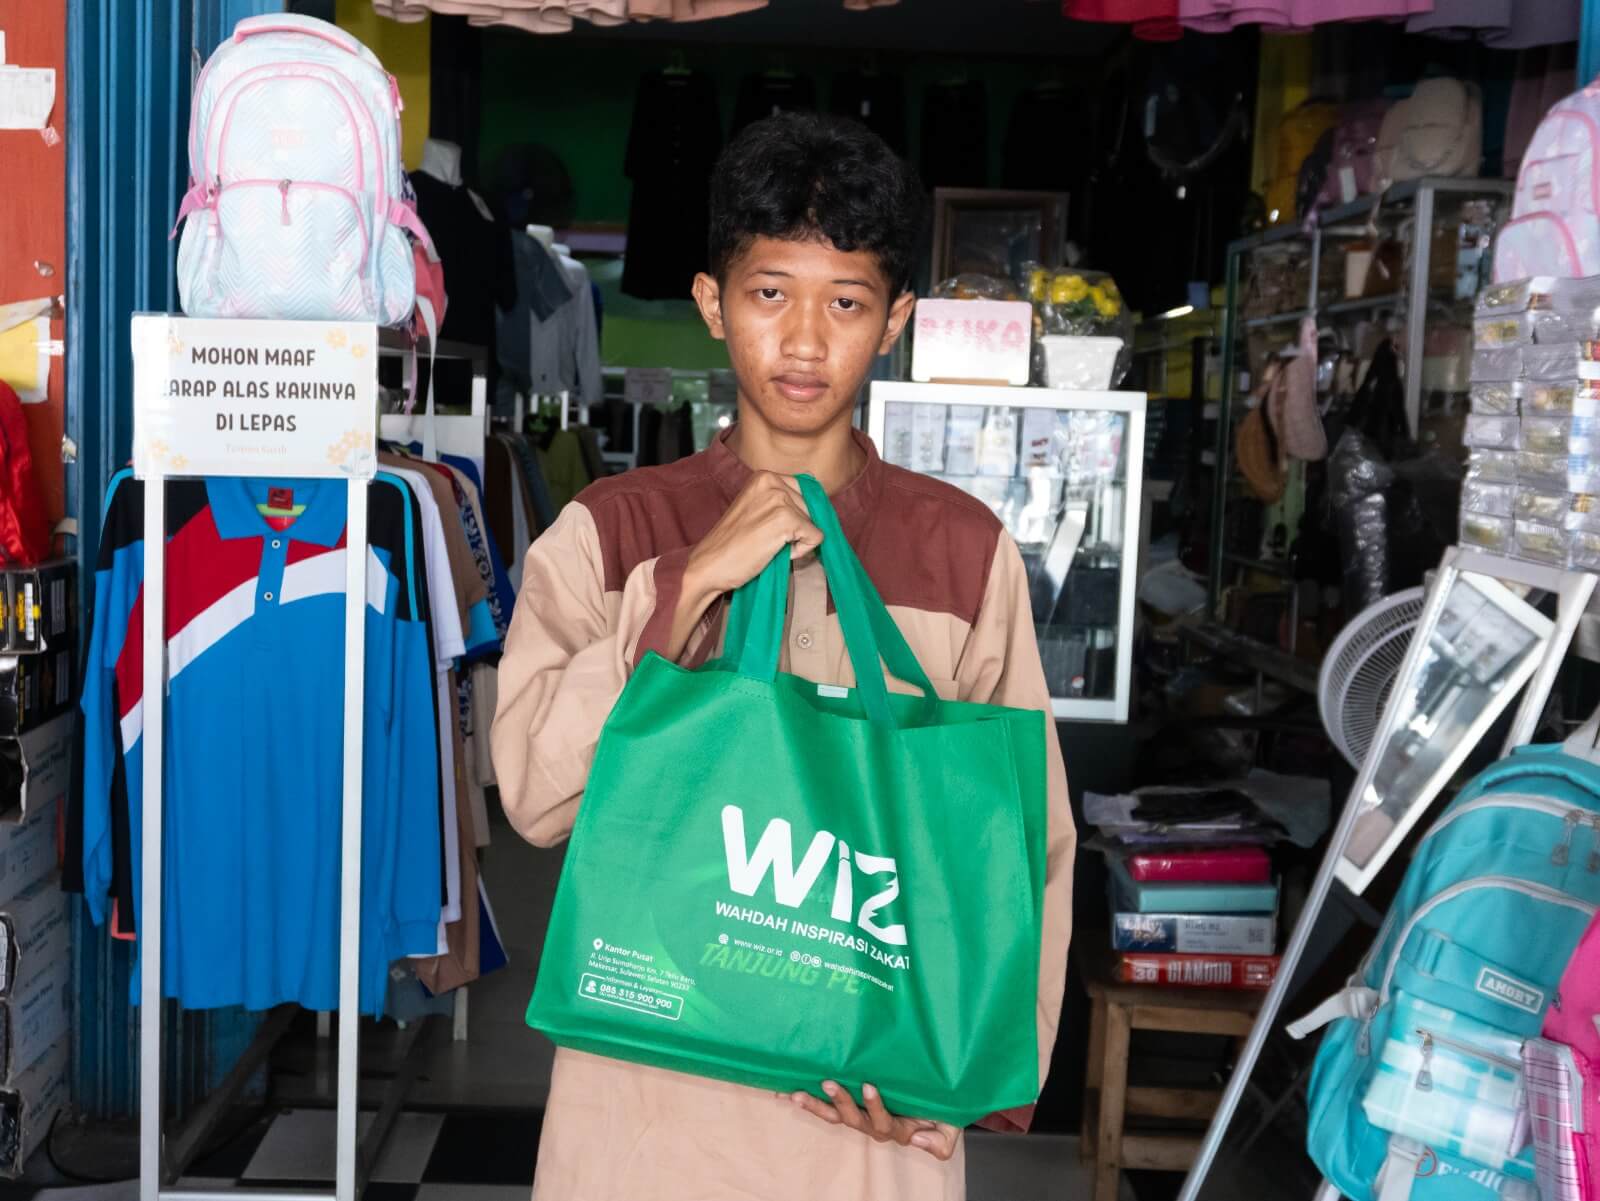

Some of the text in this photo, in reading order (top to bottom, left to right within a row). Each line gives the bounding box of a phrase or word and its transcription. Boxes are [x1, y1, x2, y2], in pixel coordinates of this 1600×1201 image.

[192, 347, 316, 367] MOHON MAAF
[163, 379, 356, 401] ARAP ALAS KAKINYA
[217, 414, 297, 432] DI LEPAS
[715, 901, 788, 932] WAHDAH
[791, 920, 868, 954] INSPIRASI
[605, 943, 653, 963] Kantor Pusat
[699, 942, 862, 994] TANJUNG PE
[1167, 960, 1233, 983] GLAMOUR
[637, 993, 654, 1004] 900
[655, 998, 673, 1009] 900
